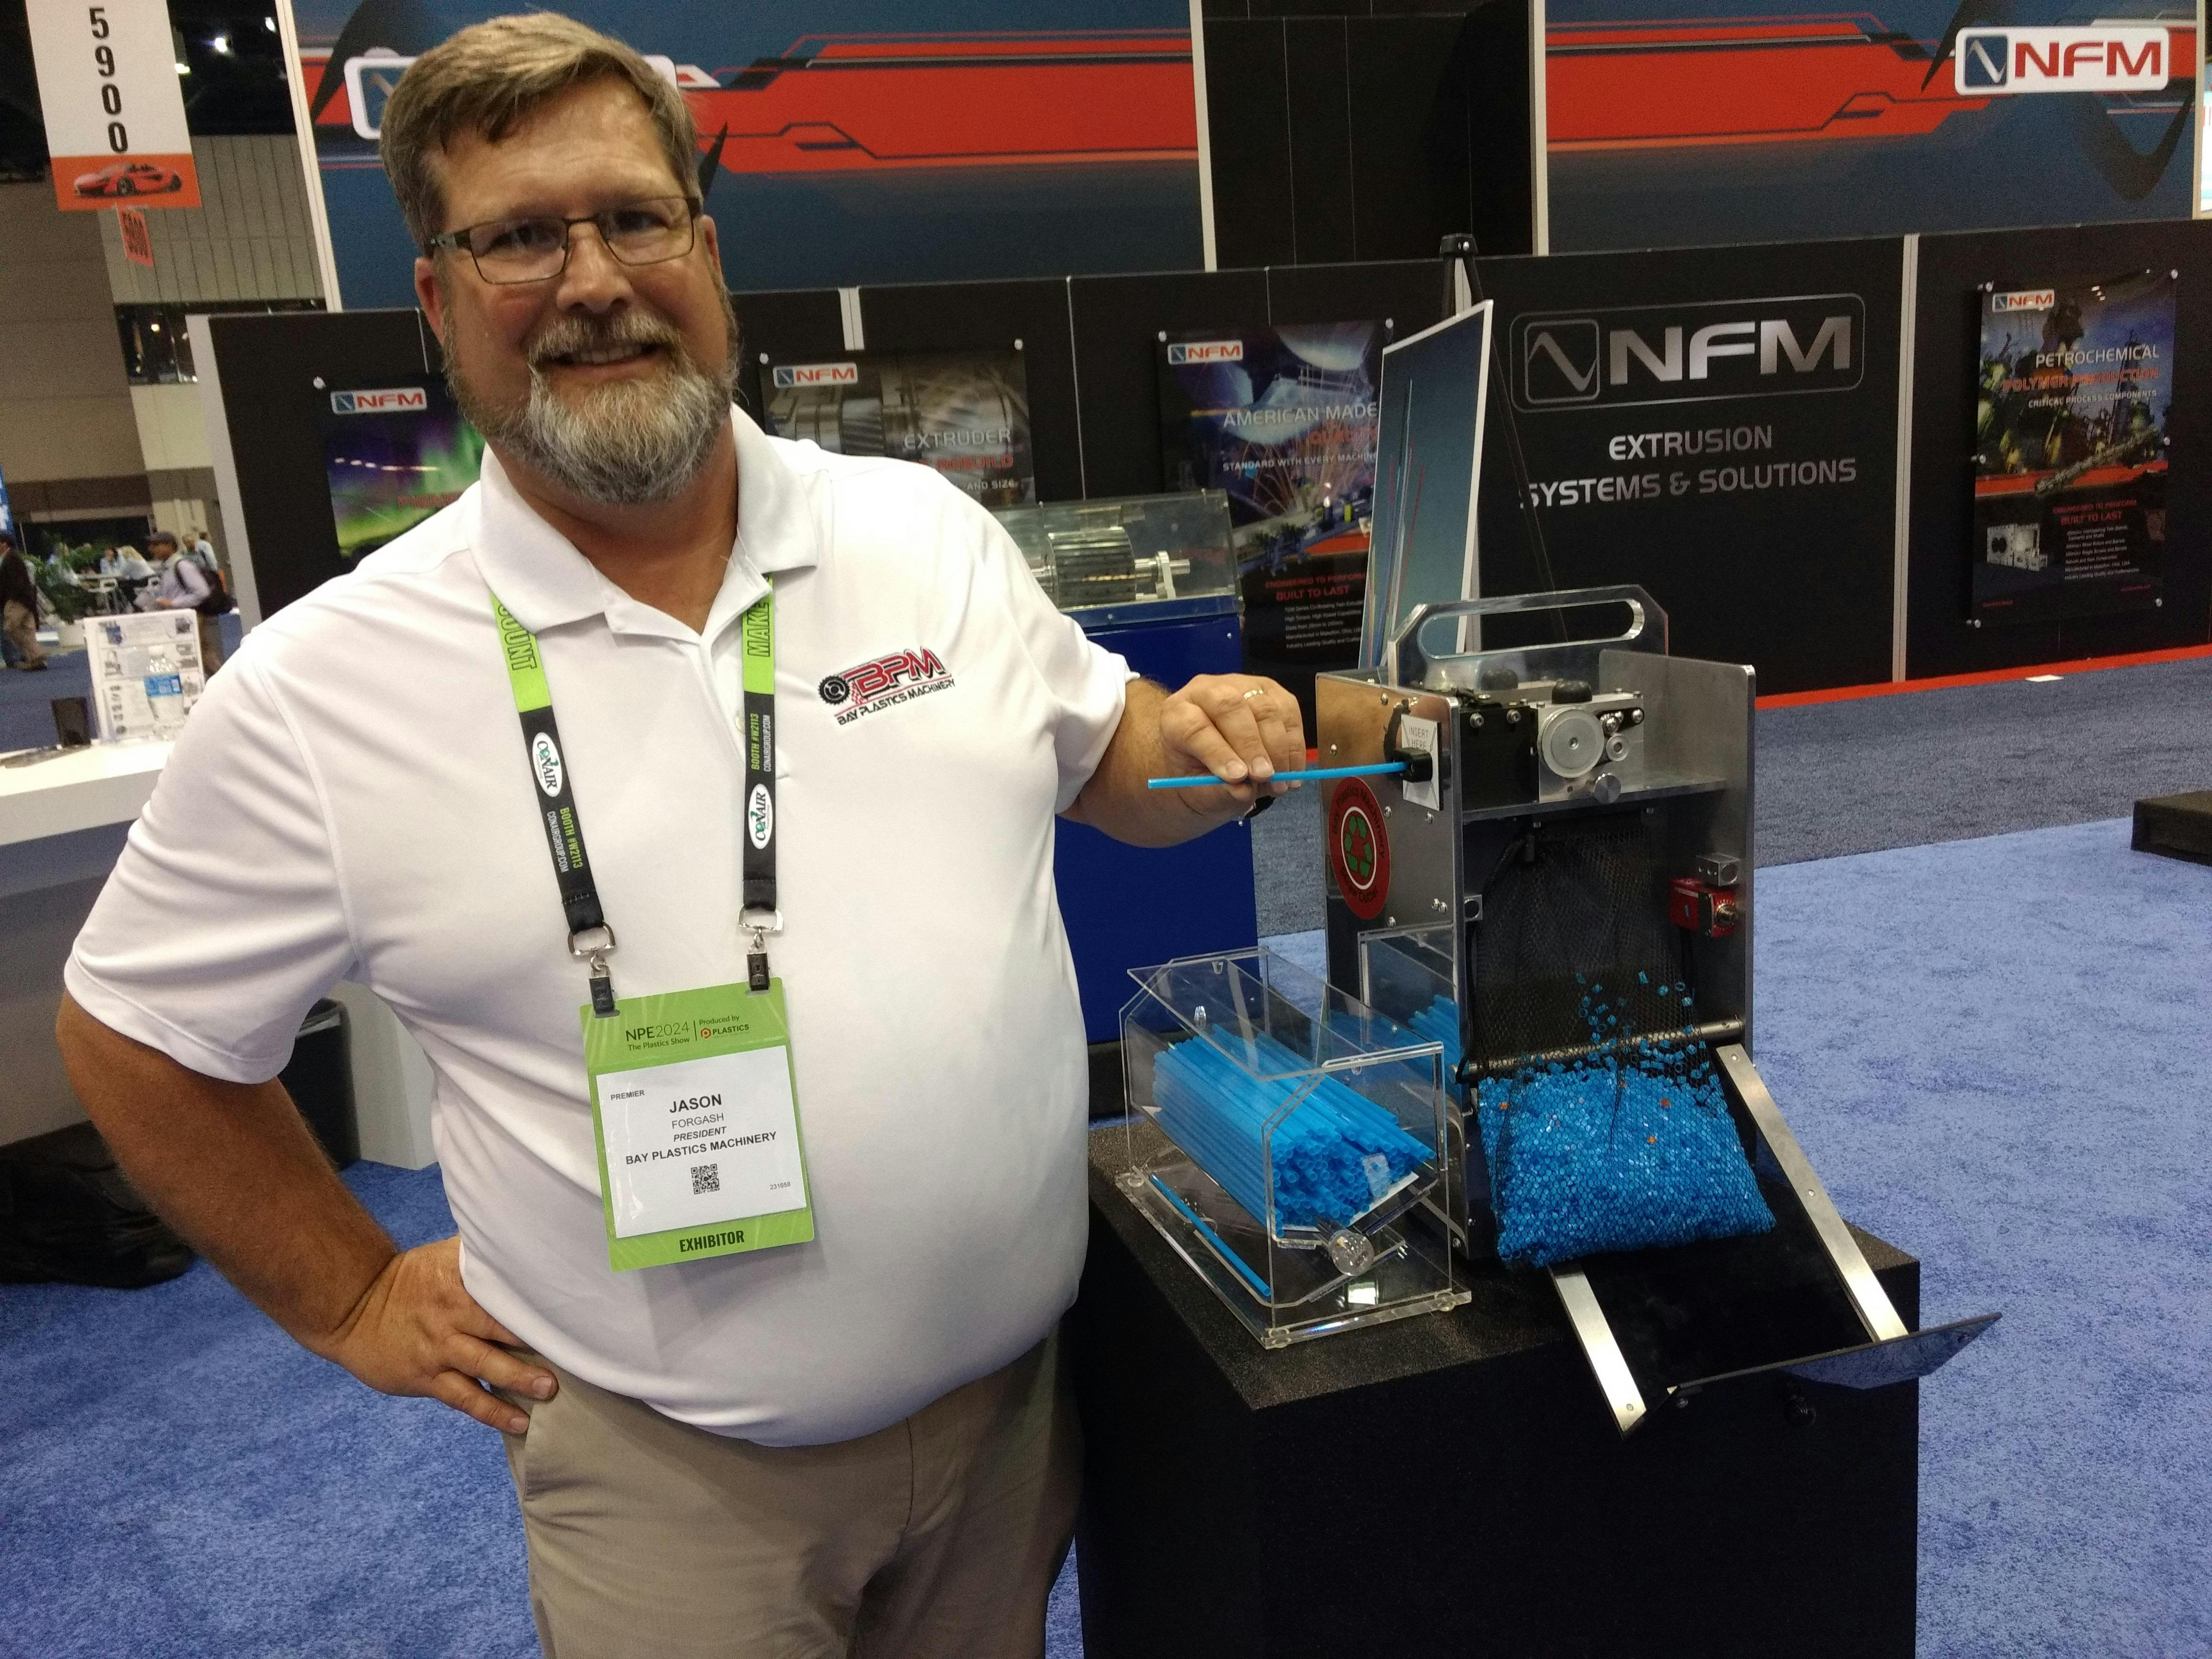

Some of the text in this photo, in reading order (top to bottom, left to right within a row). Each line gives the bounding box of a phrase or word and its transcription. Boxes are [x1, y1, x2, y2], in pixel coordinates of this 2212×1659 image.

[2015, 41, 2161, 79] NFM
[89, 6, 128, 153] 5900
[1188, 345, 1240, 359] NFM
[1610, 316, 1851, 385] NFM
[2036, 344, 2159, 368] PETROCHEMICAL
[796, 367, 854, 382] NFM
[2002, 367, 2159, 392] POLYMER PRODUCTION
[357, 393, 423, 408] NFM
[2028, 396, 2064, 408] CRITICAL
[2105, 390, 2157, 400] COMPONENTS
[1224, 401, 1377, 427] AMERICAN MADE
[904, 428, 1011, 450] EXTRUDER
[1609, 425, 1773, 461] EXTRUSION
[937, 453, 1014, 473] REBUILD
[1223, 460, 1274, 471] STANDARD
[1277, 457, 1301, 467] WITH
[1304, 454, 1334, 465] EVERY
[966, 481, 988, 490] AND
[1669, 471, 1690, 496] &
[1699, 457, 1857, 494] SOLUTIONS
[2088, 513, 2098, 522] TO
[2101, 511, 2122, 521] LAST
[1276, 585, 1349, 601] BUILT TO LAST
[841, 646, 946, 698] BPM
[837, 678, 956, 725] BAY PLASTICS MACHINERY
[1409, 726, 1429, 739] INSERT
[536, 740, 558, 790] CONAIR
[751, 743, 760, 770] BOOTH
[560, 806, 576, 837] BOOTH
[755, 790, 767, 842] CONAIR
[625, 1021, 690, 1042] NPE2024
[699, 1017, 730, 1026] Produced
[712, 1023, 749, 1035] PLASTICS
[643, 1039, 669, 1049] Plastics
[671, 1036, 690, 1046] Show
[611, 1089, 645, 1101] PREMIER
[669, 1094, 722, 1113] JASON
[672, 1113, 724, 1130] FORGASH
[673, 1126, 727, 1142] PRESIDENT
[626, 1131, 777, 1165] BAY PLASTICS MACHINERY
[770, 1181, 791, 1190] 231658
[679, 1230, 745, 1252] EXHIBITOR
